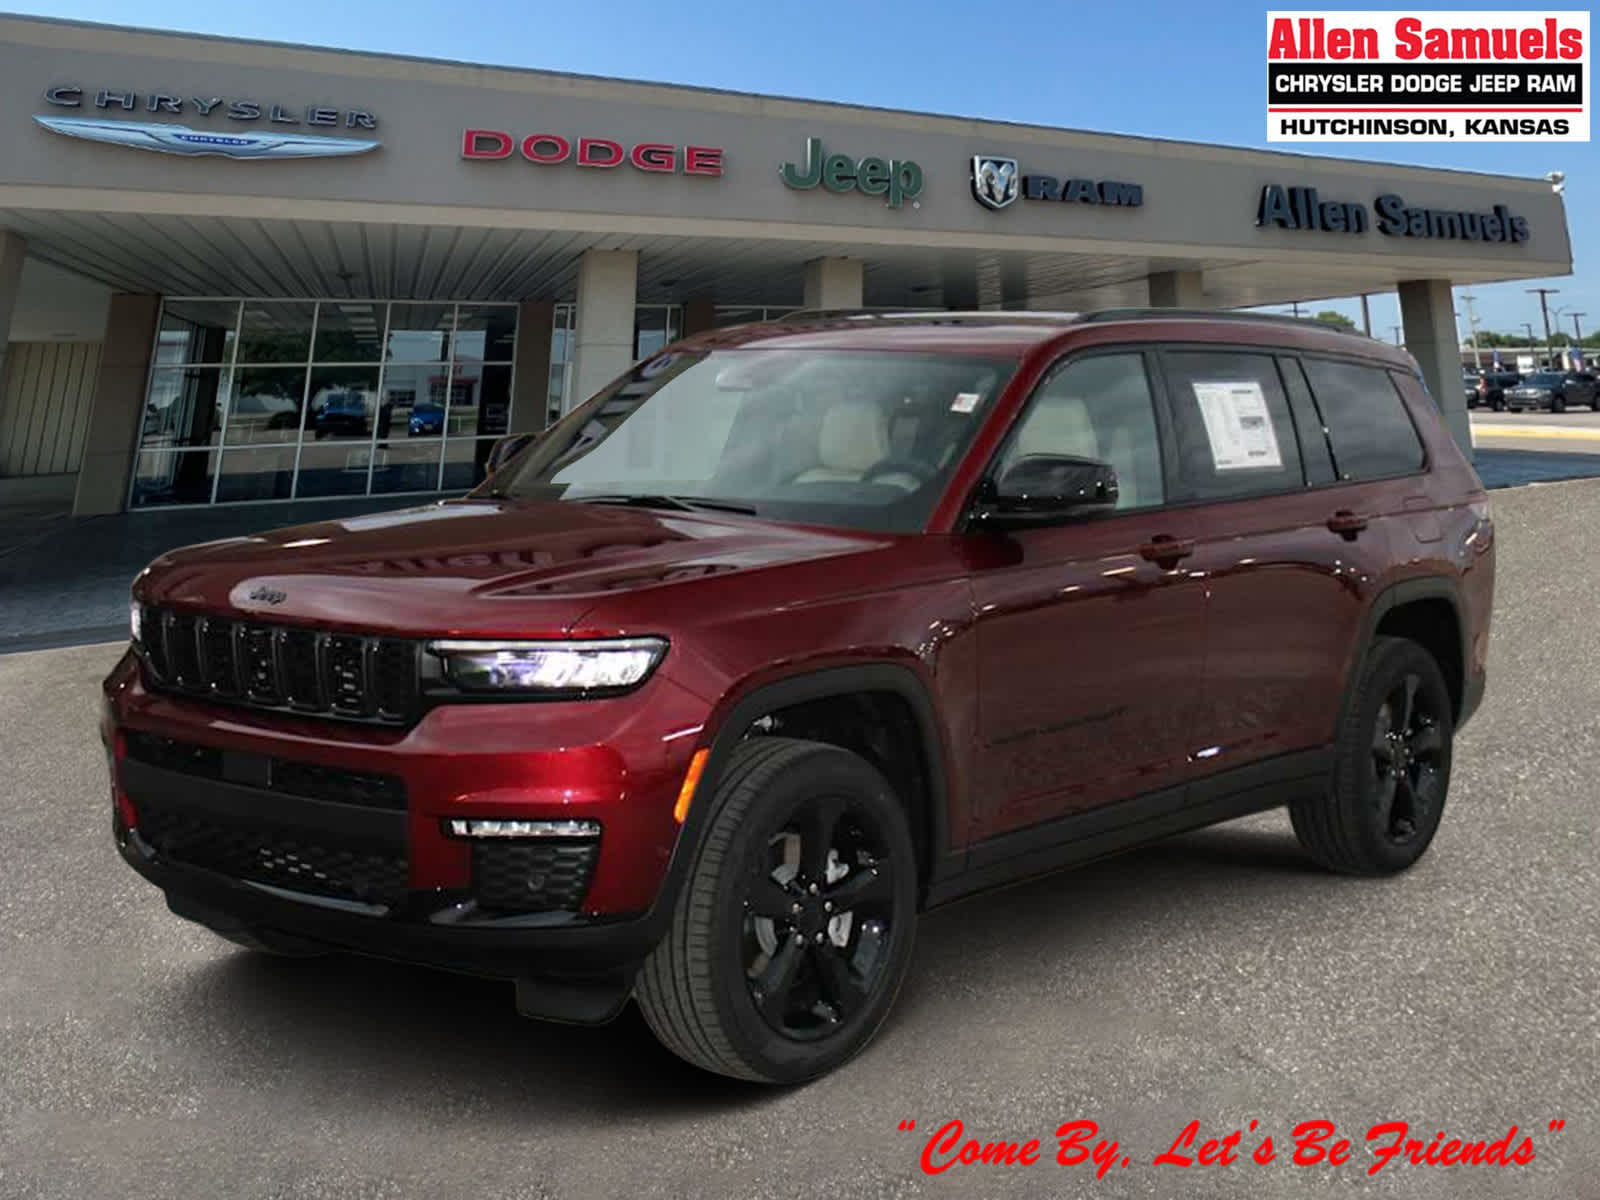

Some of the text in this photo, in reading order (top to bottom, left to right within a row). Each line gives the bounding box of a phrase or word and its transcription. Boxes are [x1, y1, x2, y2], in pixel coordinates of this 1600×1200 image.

[45, 86, 377, 129] CHRYSLER
[462, 128, 725, 176] DODGE
[780, 136, 923, 209] Jeep
[1022, 175, 1144, 208] RAM
[1257, 184, 1531, 244] Allen Samuels
